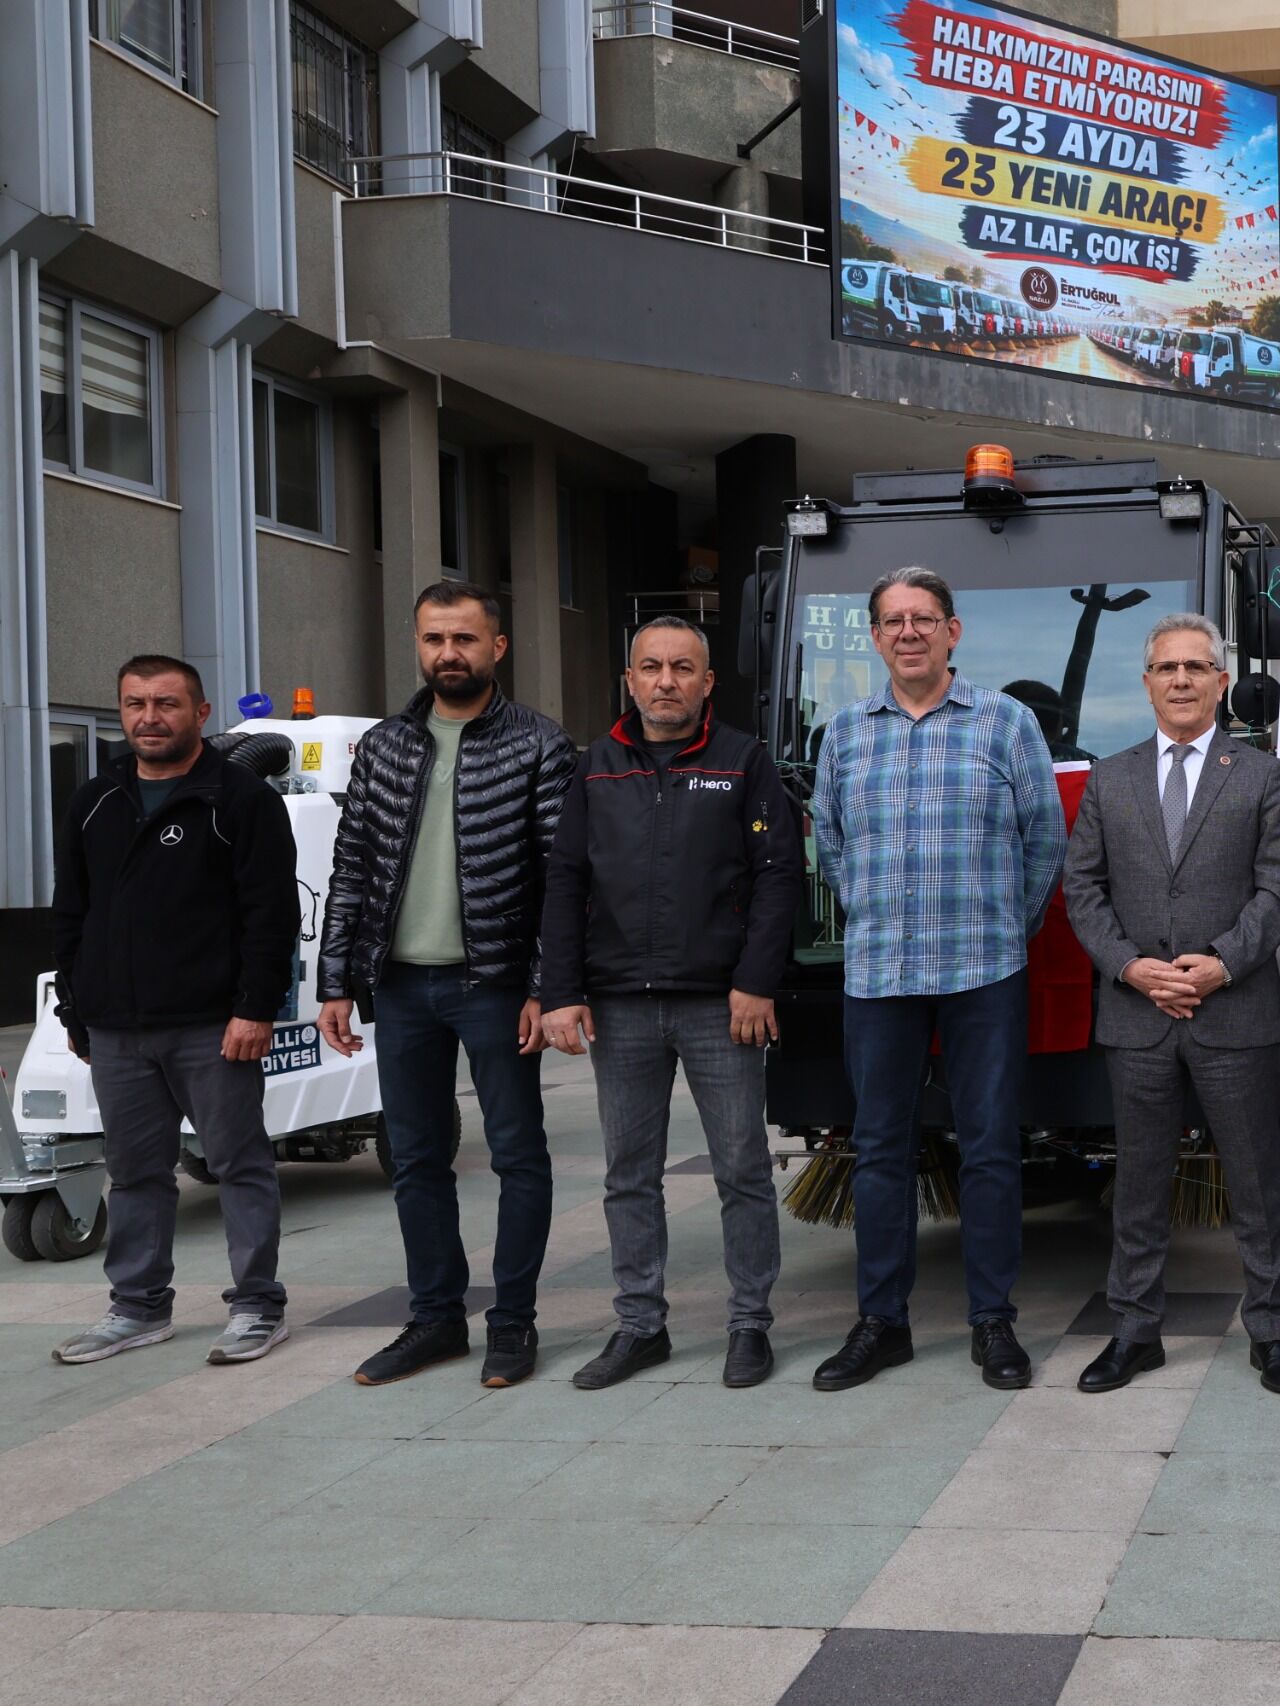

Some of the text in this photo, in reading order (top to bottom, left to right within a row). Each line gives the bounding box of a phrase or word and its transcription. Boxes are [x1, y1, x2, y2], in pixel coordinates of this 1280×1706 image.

[931, 48, 1015, 95] HEBA
[933, 15, 1202, 107] HALKIMIZIN PARASINI
[993, 105, 1159, 176] 23 AYDA
[941, 148, 997, 196] 23
[1098, 181, 1208, 238] ARAÇ!
[979, 215, 1017, 245] AZ
[1024, 222, 1078, 260] LAF,
[1086, 232, 1140, 265] ÇOK
[1060, 283, 1121, 306] ERTUĞRUL
[700, 779, 732, 791] Hero
